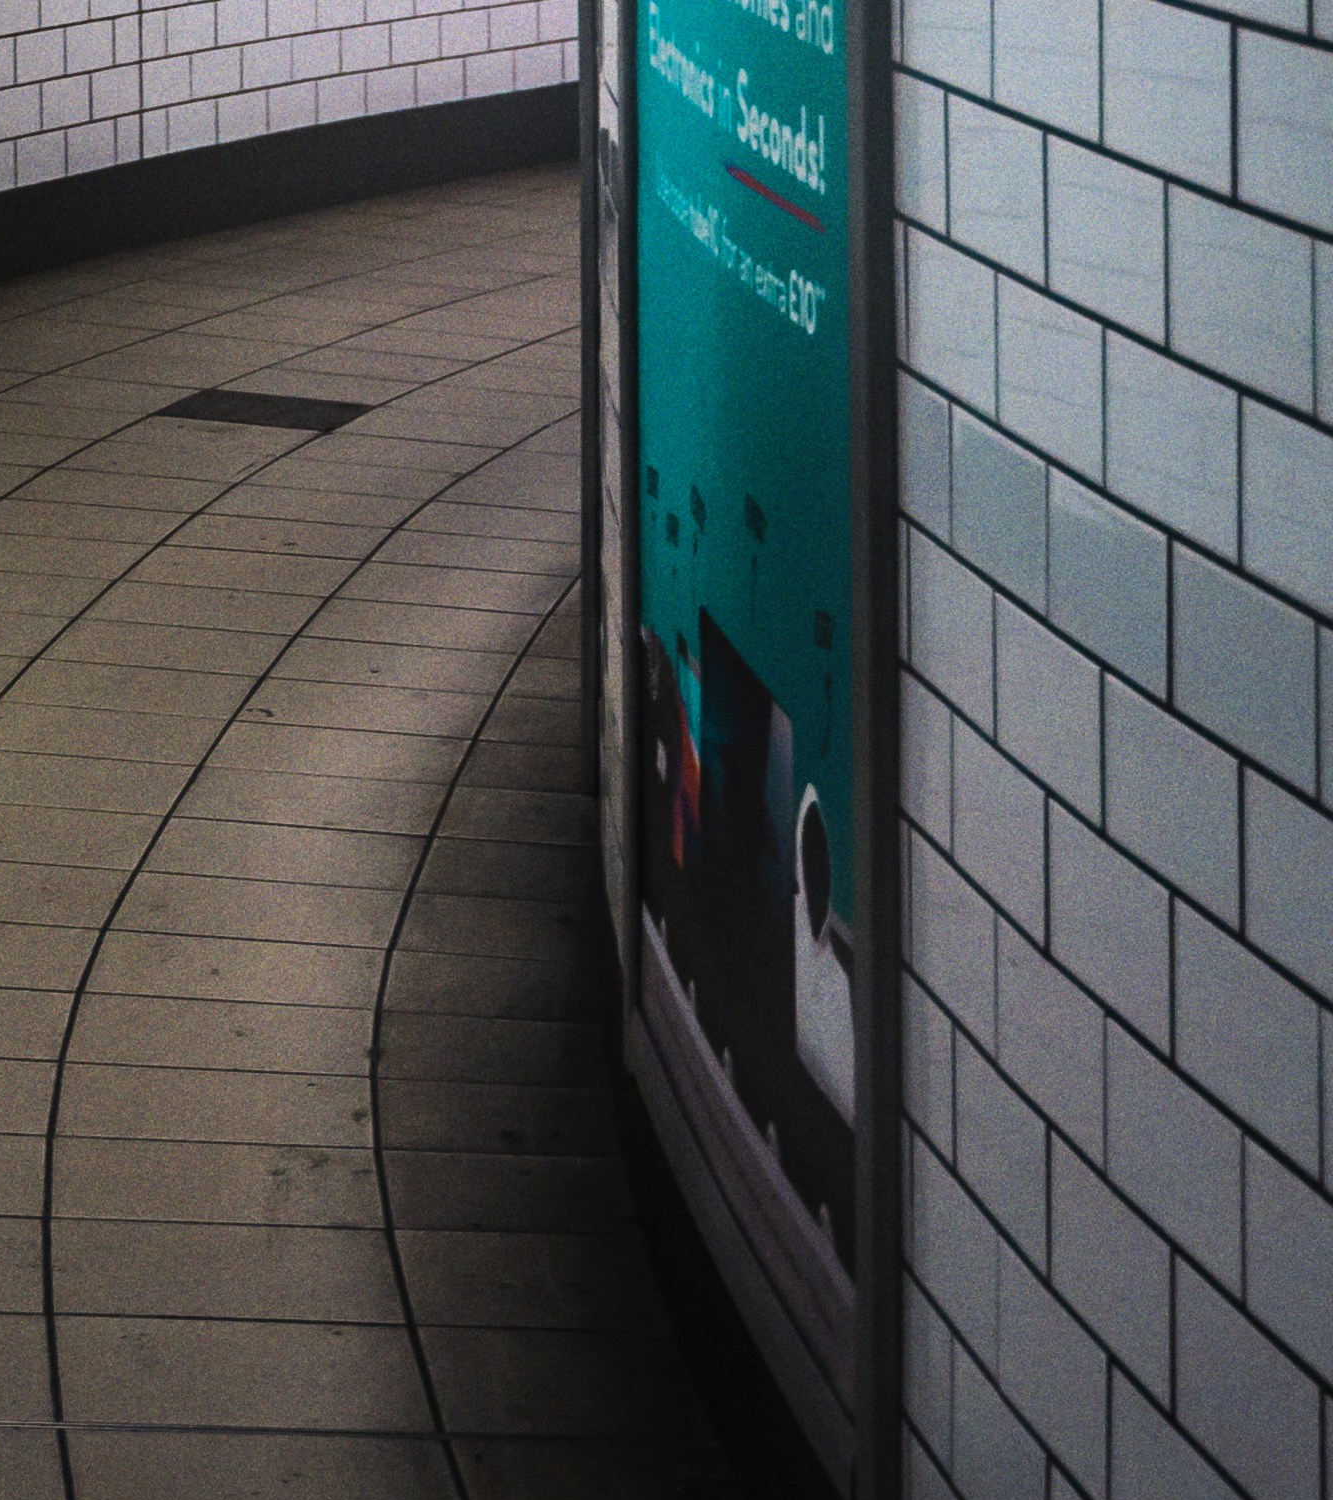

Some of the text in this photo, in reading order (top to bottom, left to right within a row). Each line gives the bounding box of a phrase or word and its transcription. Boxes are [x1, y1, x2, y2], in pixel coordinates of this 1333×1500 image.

[648, 0, 826, 195] Electronics in Seconds!
